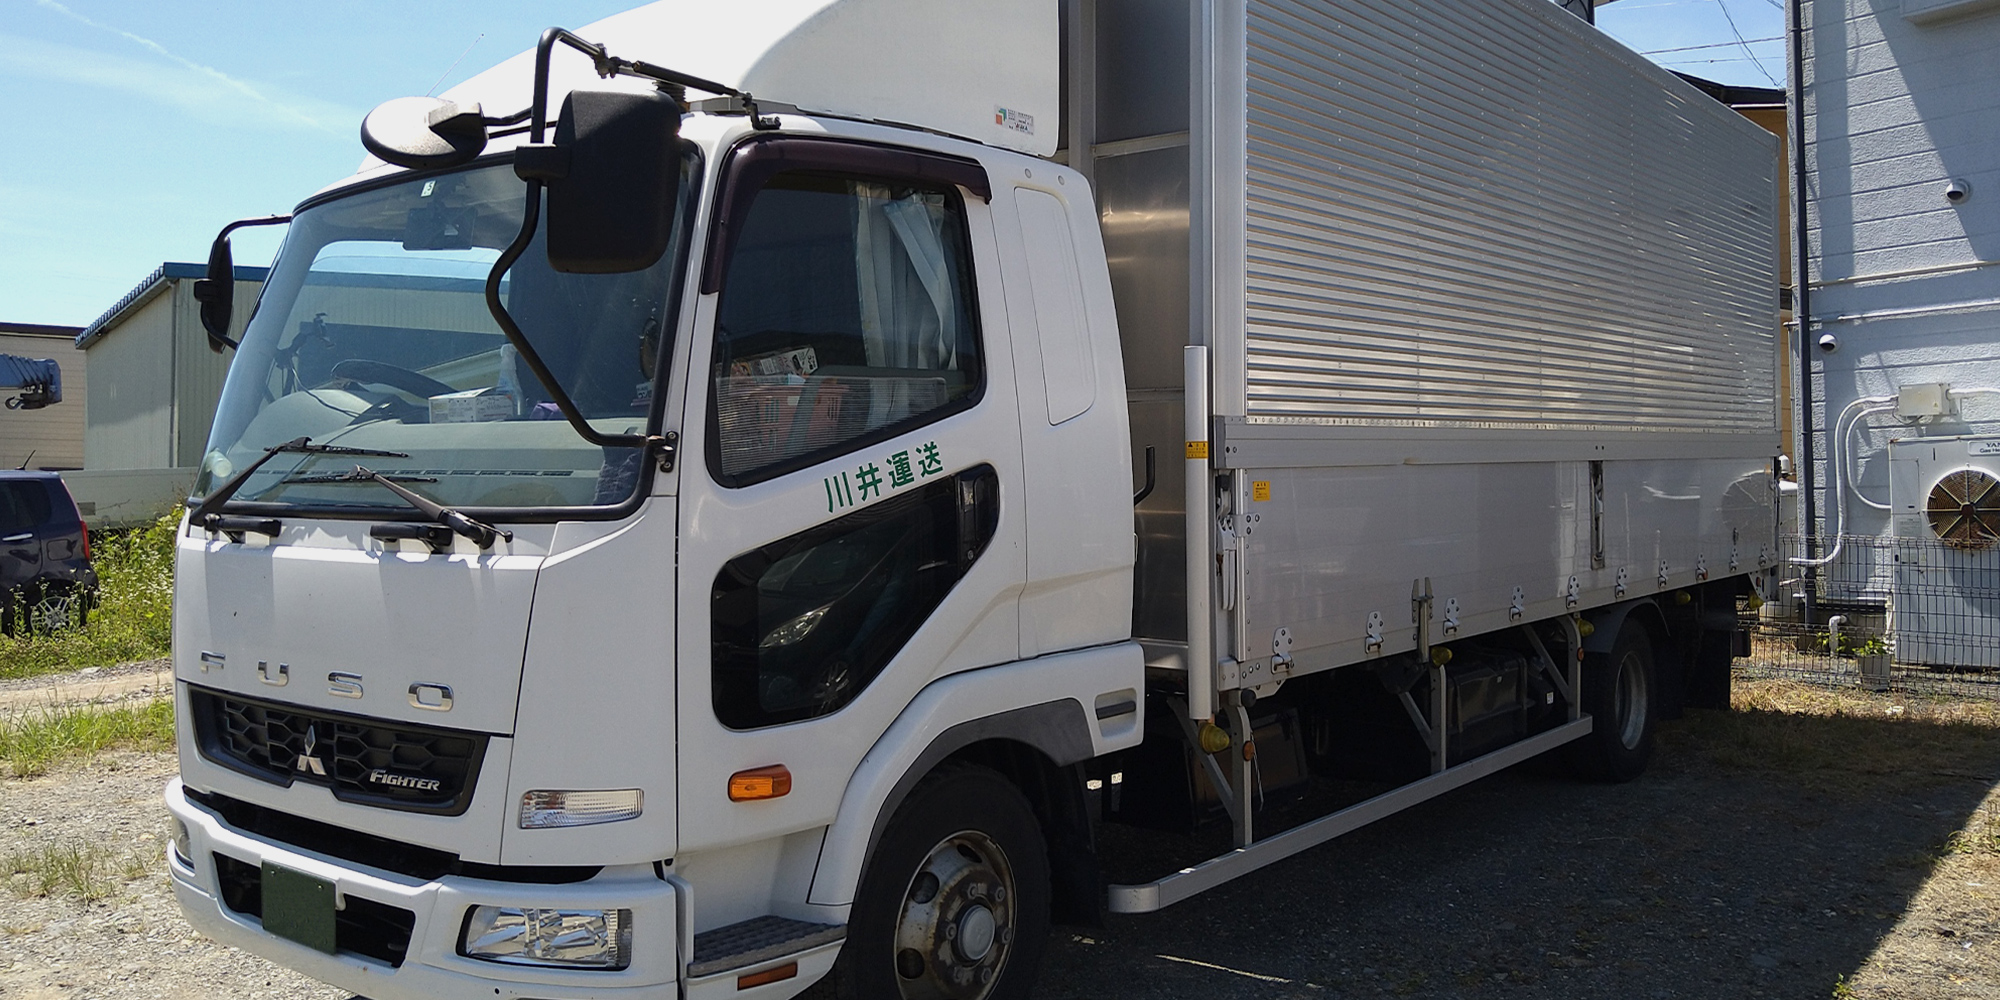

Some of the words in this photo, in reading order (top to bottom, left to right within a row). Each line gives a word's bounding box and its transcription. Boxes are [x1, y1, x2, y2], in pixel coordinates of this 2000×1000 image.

[823, 441, 943, 513] 川井運送
[201, 650, 454, 712] FUSO
[370, 769, 441, 791] FIGHTER
